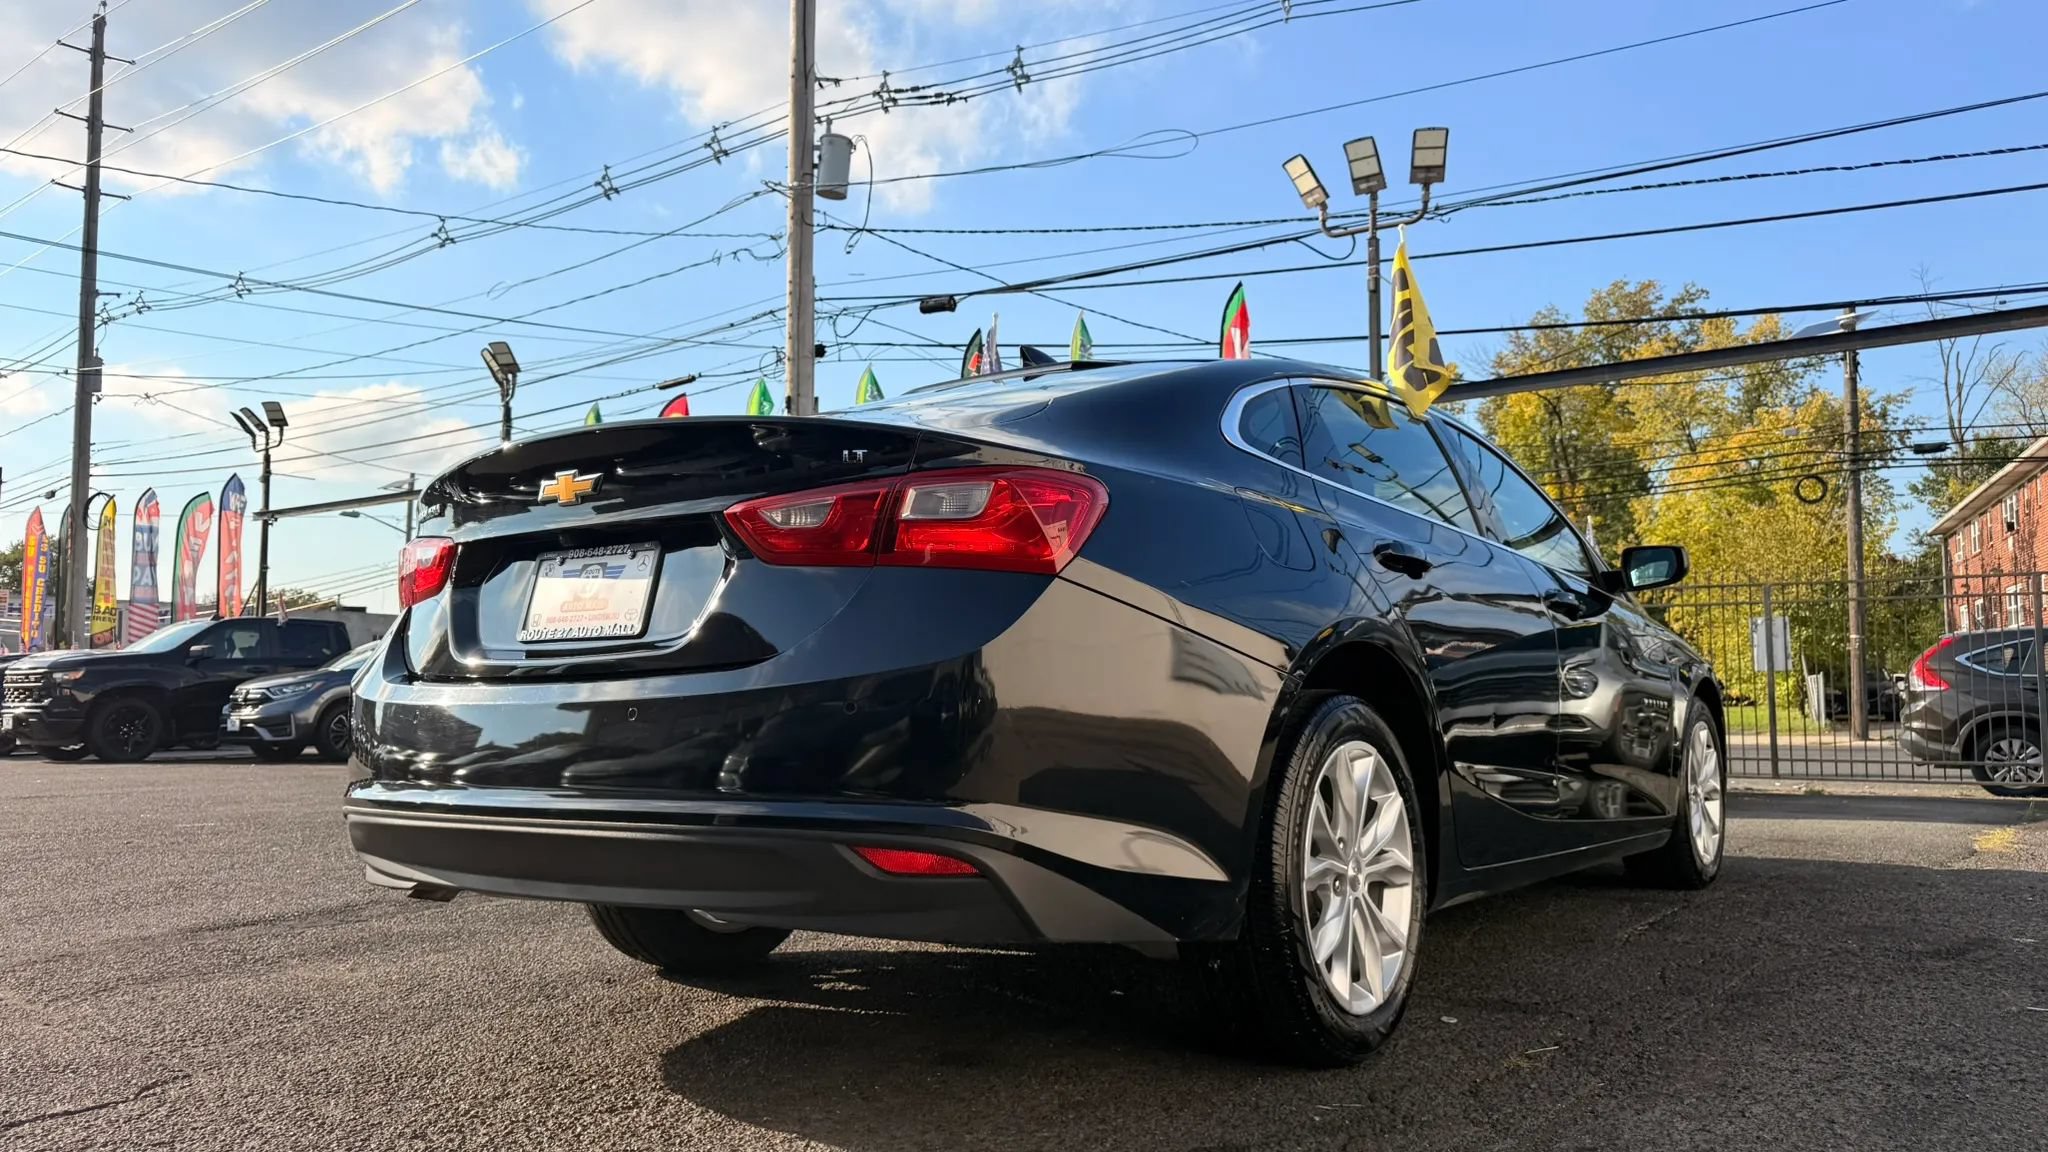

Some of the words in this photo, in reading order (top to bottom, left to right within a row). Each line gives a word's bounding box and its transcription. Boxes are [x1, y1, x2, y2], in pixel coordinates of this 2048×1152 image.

[842, 449, 868, 464] LT
[520, 628, 555, 641] ROUTE
[557, 627, 572, 638] 27
[571, 625, 603, 637] AUTO
[604, 623, 634, 636] MALL
